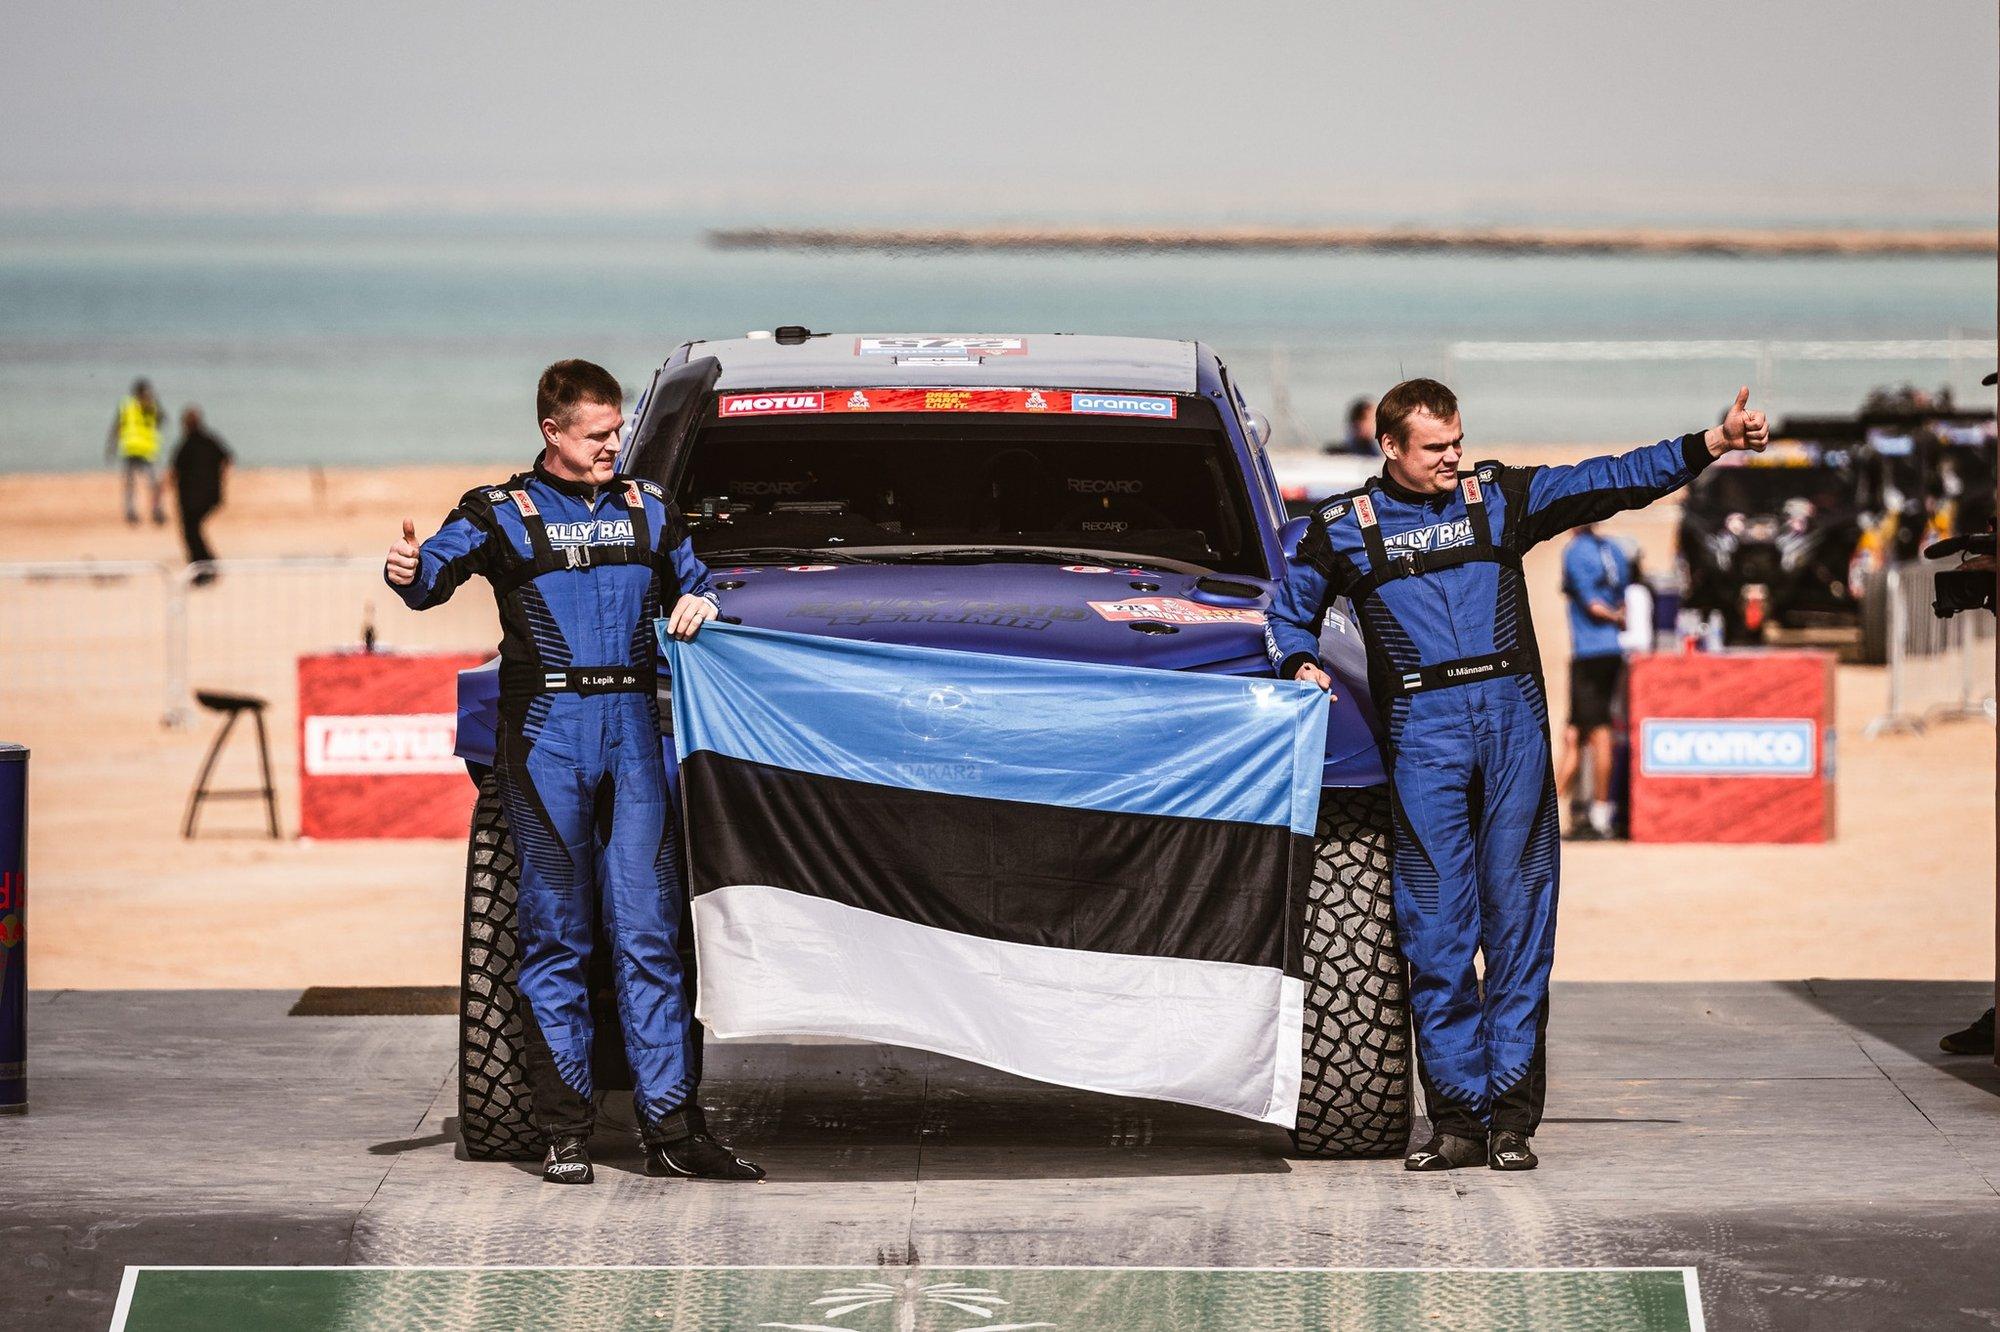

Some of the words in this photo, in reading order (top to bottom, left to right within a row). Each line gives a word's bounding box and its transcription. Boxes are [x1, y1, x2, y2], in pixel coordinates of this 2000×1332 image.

[728, 396, 818, 411] MOTUL
[1078, 398, 1166, 411] aramco
[1067, 479, 1143, 493] RECARO
[1467, 479, 1478, 502] SIMPSON
[1323, 505, 1345, 520] OMP
[1357, 499, 1372, 523] SIMPSON
[546, 523, 593, 540] ALLY
[601, 522, 635, 539] RAI
[1082, 521, 1128, 531] RECARO
[1383, 527, 1432, 548] ALLY
[1131, 610, 1182, 621] SAUDI
[582, 677, 591, 685] R.
[593, 675, 615, 686] Lepik
[1653, 730, 1803, 764] aramco
